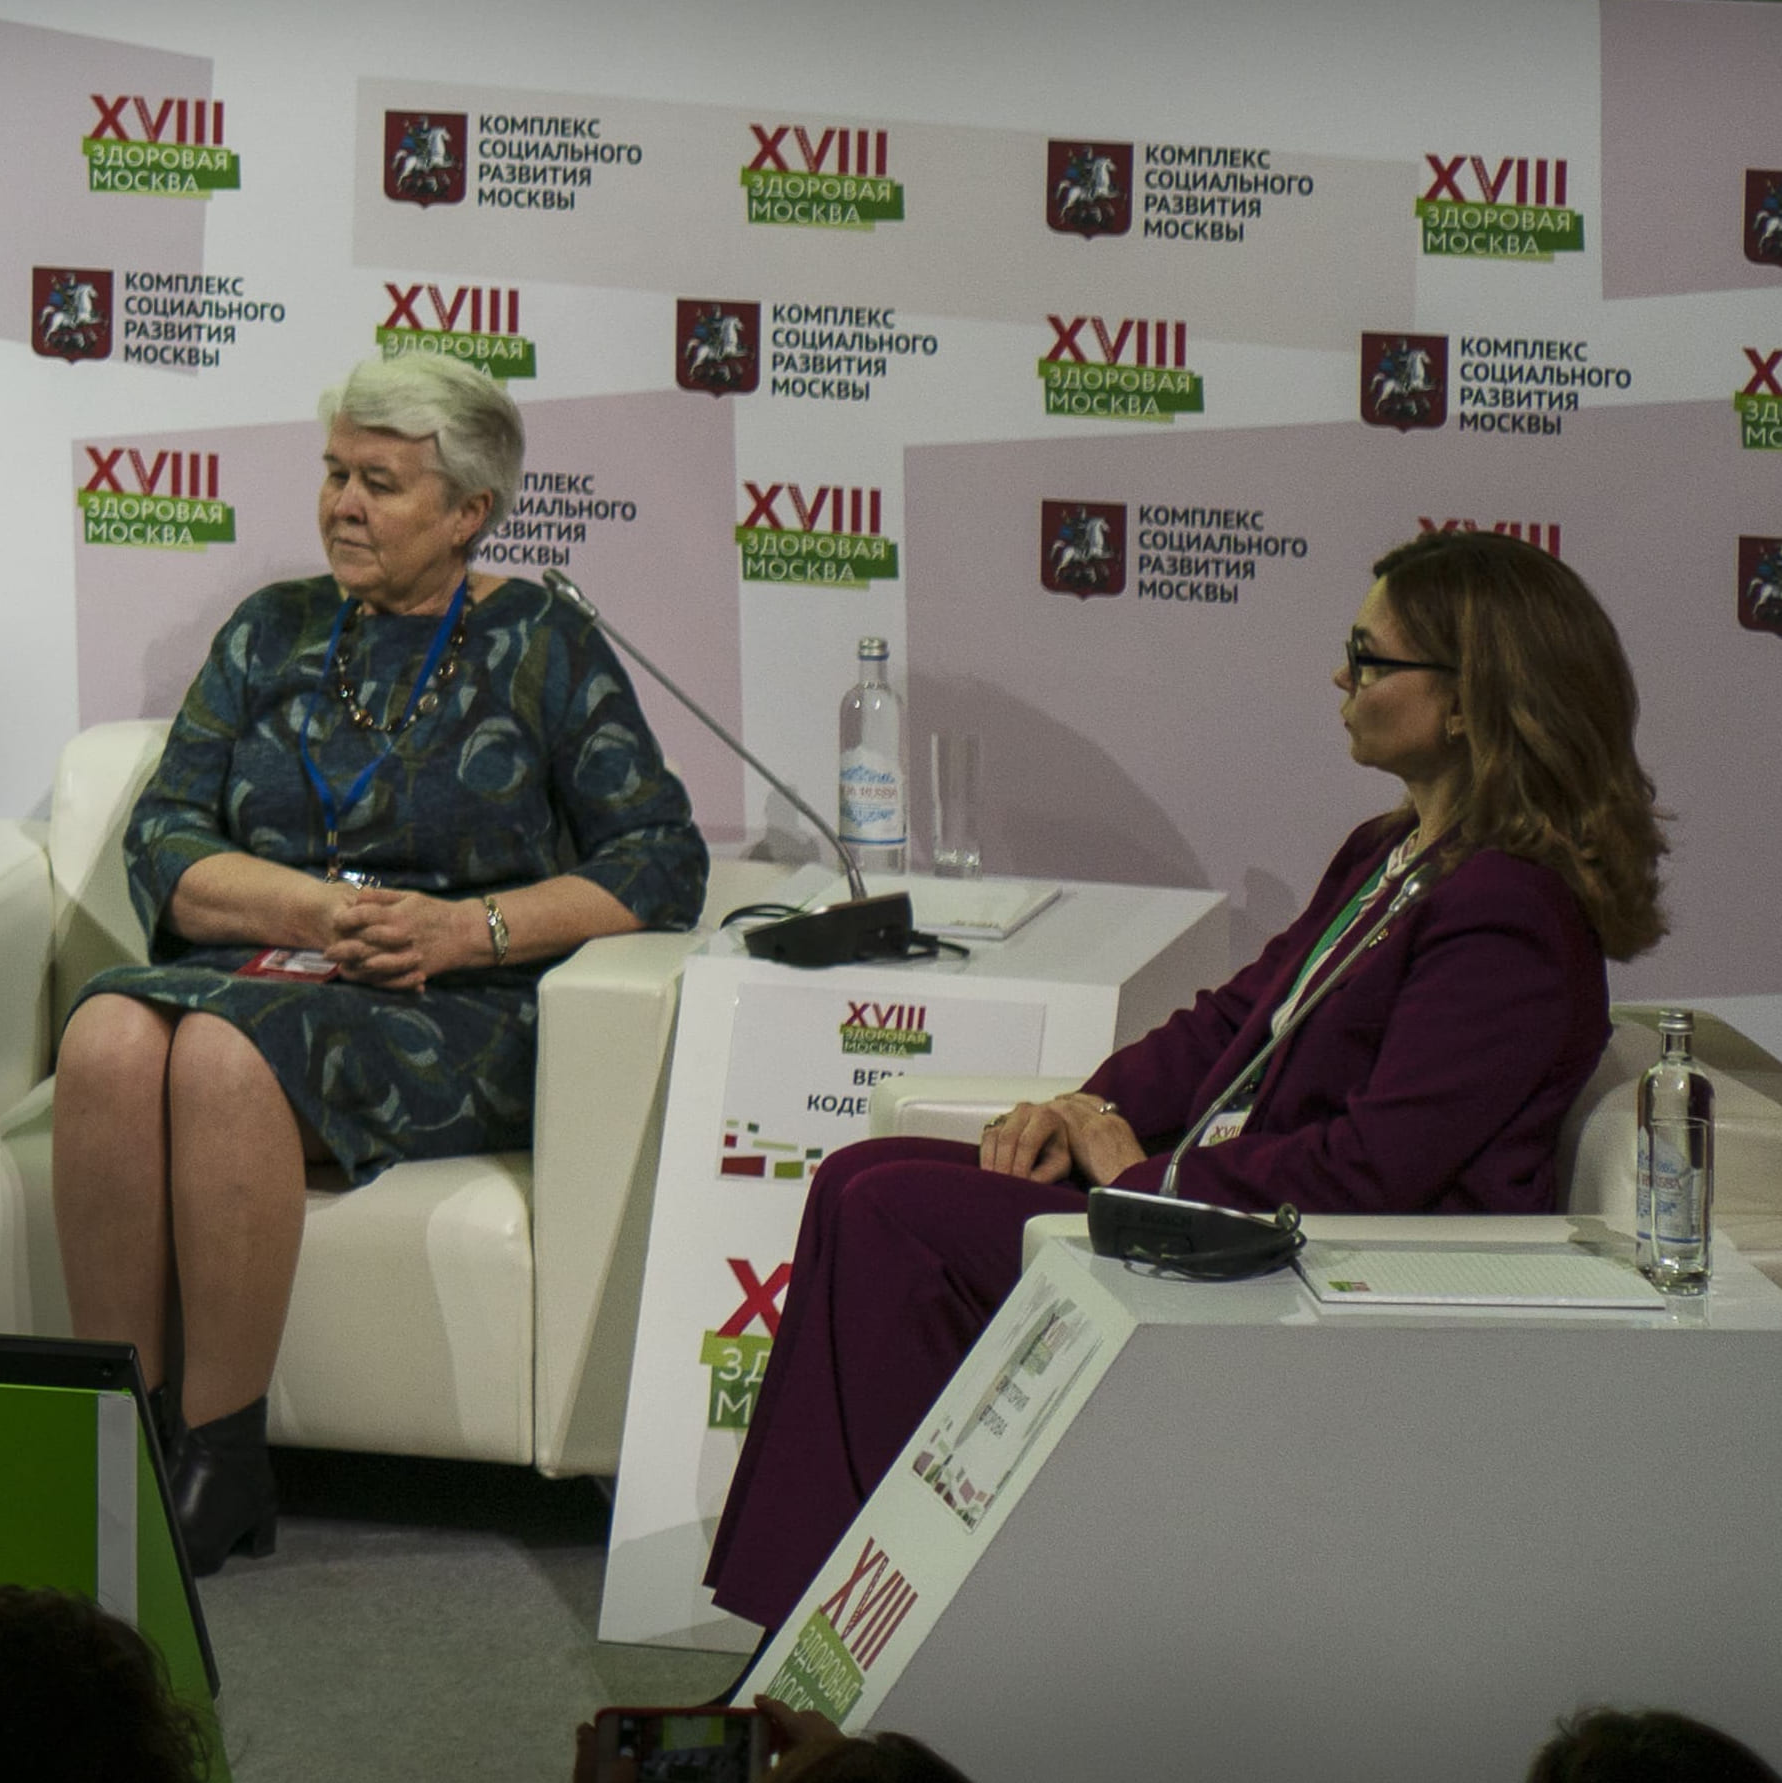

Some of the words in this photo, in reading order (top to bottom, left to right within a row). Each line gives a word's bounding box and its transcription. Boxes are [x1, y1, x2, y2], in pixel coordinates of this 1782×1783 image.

[90, 93, 222, 146] XVIII
[479, 114, 600, 140] КОМПЛЕКС
[91, 146, 228, 170] ЗДОРОВАЯ
[478, 138, 643, 165] СОЦИАЛЬНОГО
[92, 170, 200, 192] МОСКВА
[478, 162, 592, 187] РАЗВИТИЯ
[1425, 153, 1564, 207] XVIII
[477, 187, 575, 211] МОСКВЫ
[1426, 207, 1571, 232] ЗДОРОВАЯ
[1427, 233, 1541, 256] МОСКВА
[124, 271, 244, 297] КОМПЛЕКС
[124, 295, 286, 323] СОЦИАЛЬНОГО
[124, 319, 236, 345] РАЗВИТИЯ
[1047, 314, 1185, 368] XVIII
[123, 343, 220, 368] МОСКВЫ
[1460, 336, 1588, 363] КОМПЛЕКС
[1048, 368, 1192, 393] ЗДОРОВАЯ
[1459, 361, 1632, 390] СОЦИАЛЬНОГО
[1049, 394, 1162, 417] МОСКВА
[1459, 385, 1579, 411] РАЗВИТИЯ
[1459, 411, 1562, 436] МОСКВЫ
[743, 482, 879, 536] XVIII
[1138, 504, 1264, 532] КОМПЛЕКС
[744, 537, 886, 561] ЗДОРОВАЯ
[1137, 529, 1308, 559] СОЦИАЛЬНОГО
[745, 562, 856, 584] МОСКВА
[1138, 553, 1256, 580] РАЗВИТИЯ
[1137, 578, 1239, 604] МОСКВЫ
[845, 1000, 926, 1031] XVIII
